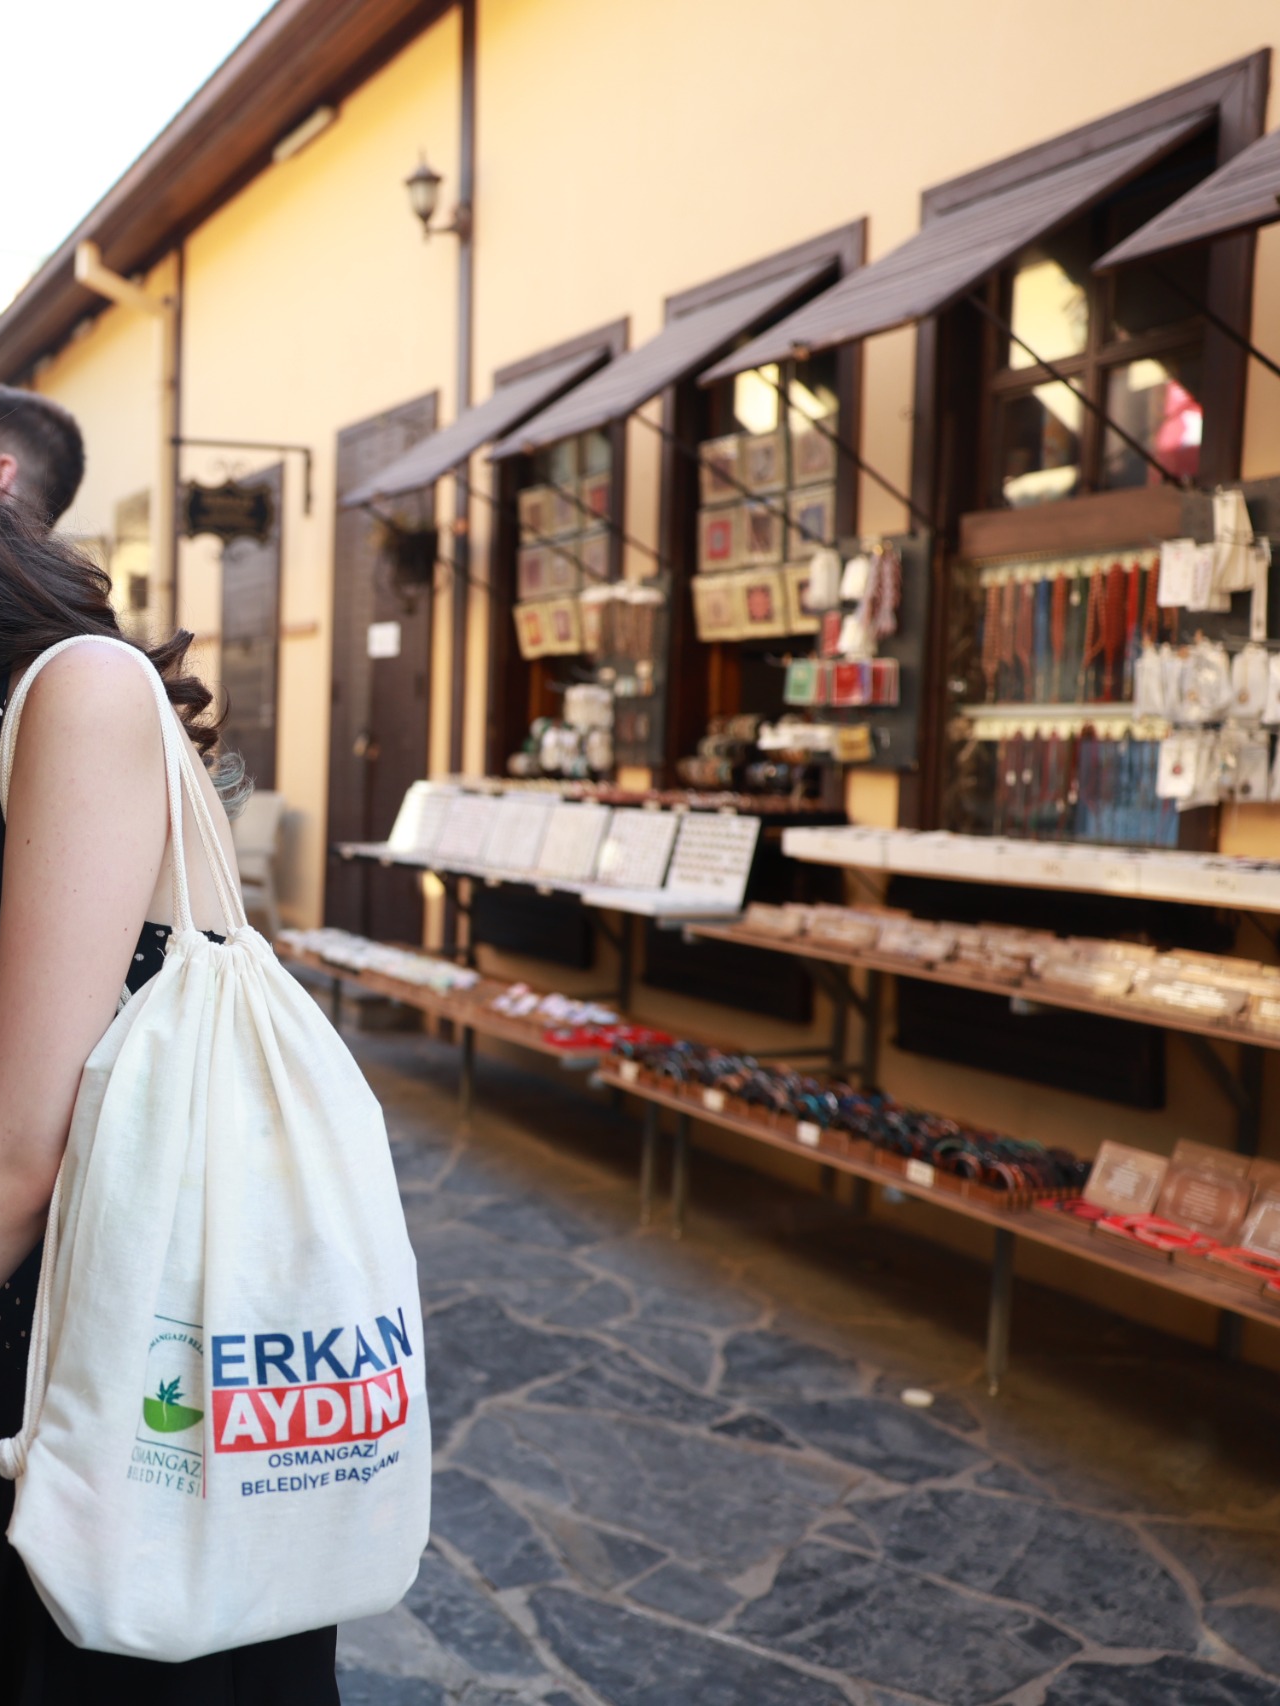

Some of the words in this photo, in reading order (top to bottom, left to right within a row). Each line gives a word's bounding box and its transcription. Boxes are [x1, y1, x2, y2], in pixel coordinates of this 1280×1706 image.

[211, 1307, 413, 1387] ERKAN
[220, 1373, 401, 1445] AYDIN
[241, 1472, 330, 1497] BELEDİYE
[335, 1451, 400, 1485] BAŞKANI
[268, 1440, 379, 1468] OSMANGAZİ
